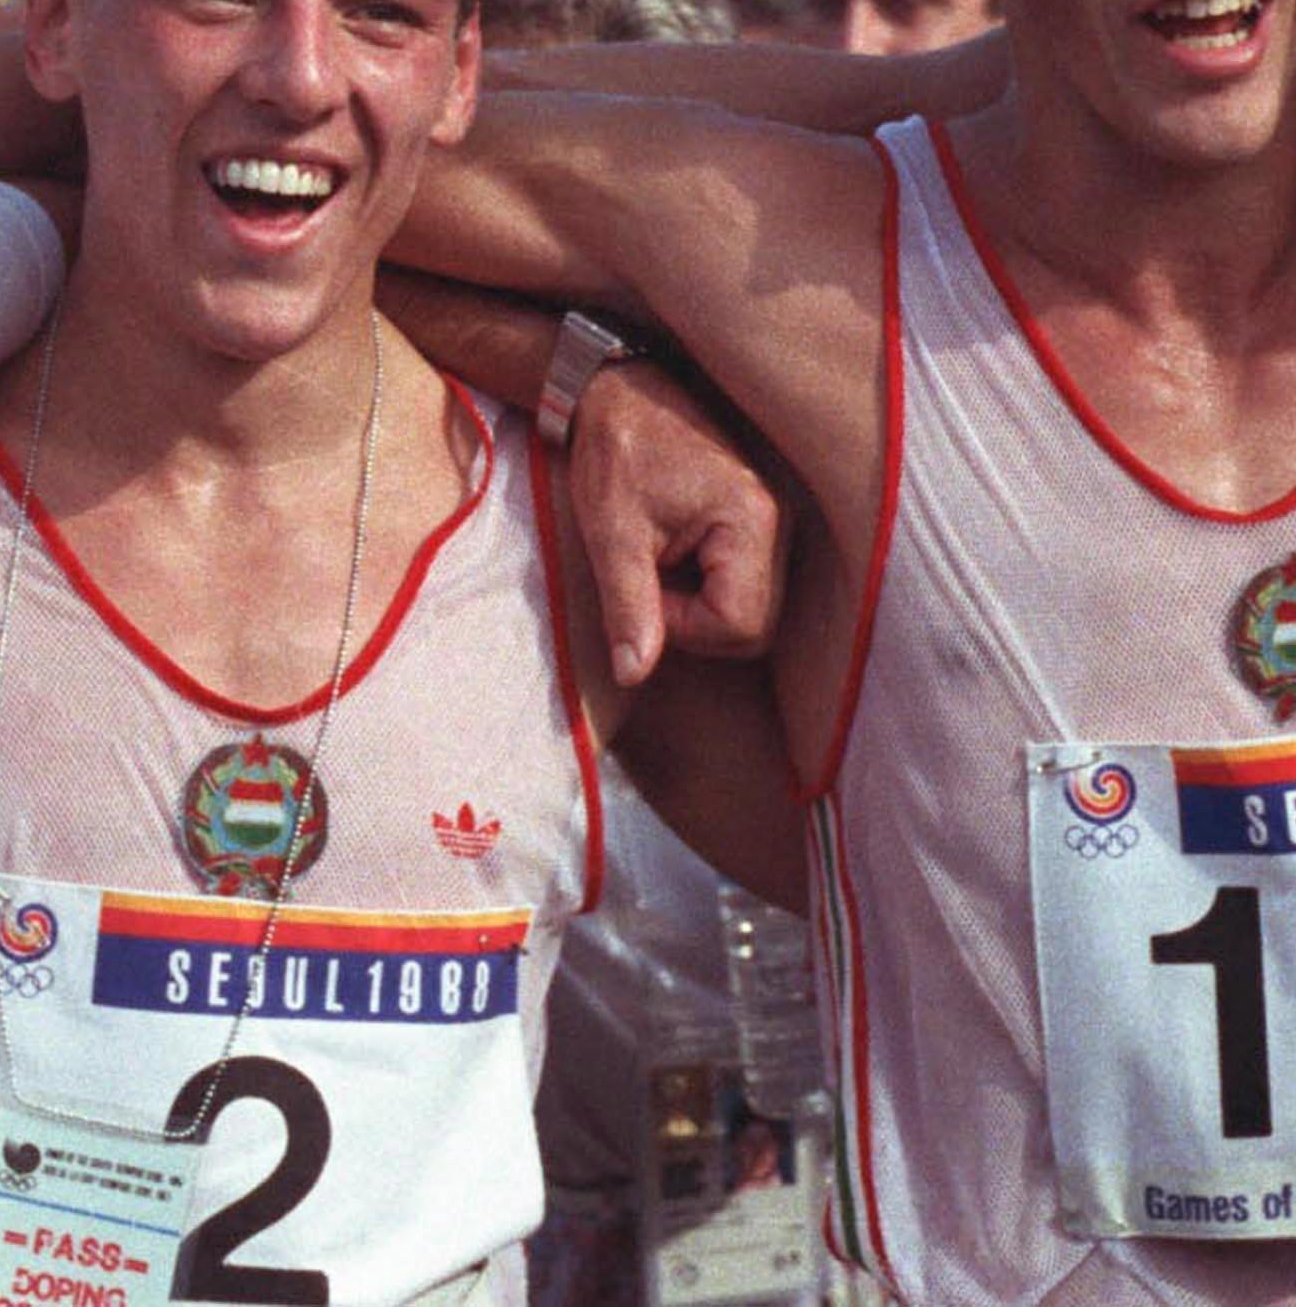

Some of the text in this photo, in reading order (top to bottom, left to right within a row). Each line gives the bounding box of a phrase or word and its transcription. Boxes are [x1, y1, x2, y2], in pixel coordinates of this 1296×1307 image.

[164, 1055, 331, 1305] 2
[1144, 1185, 1249, 1223] Games
[1262, 1183, 1293, 1219] of
